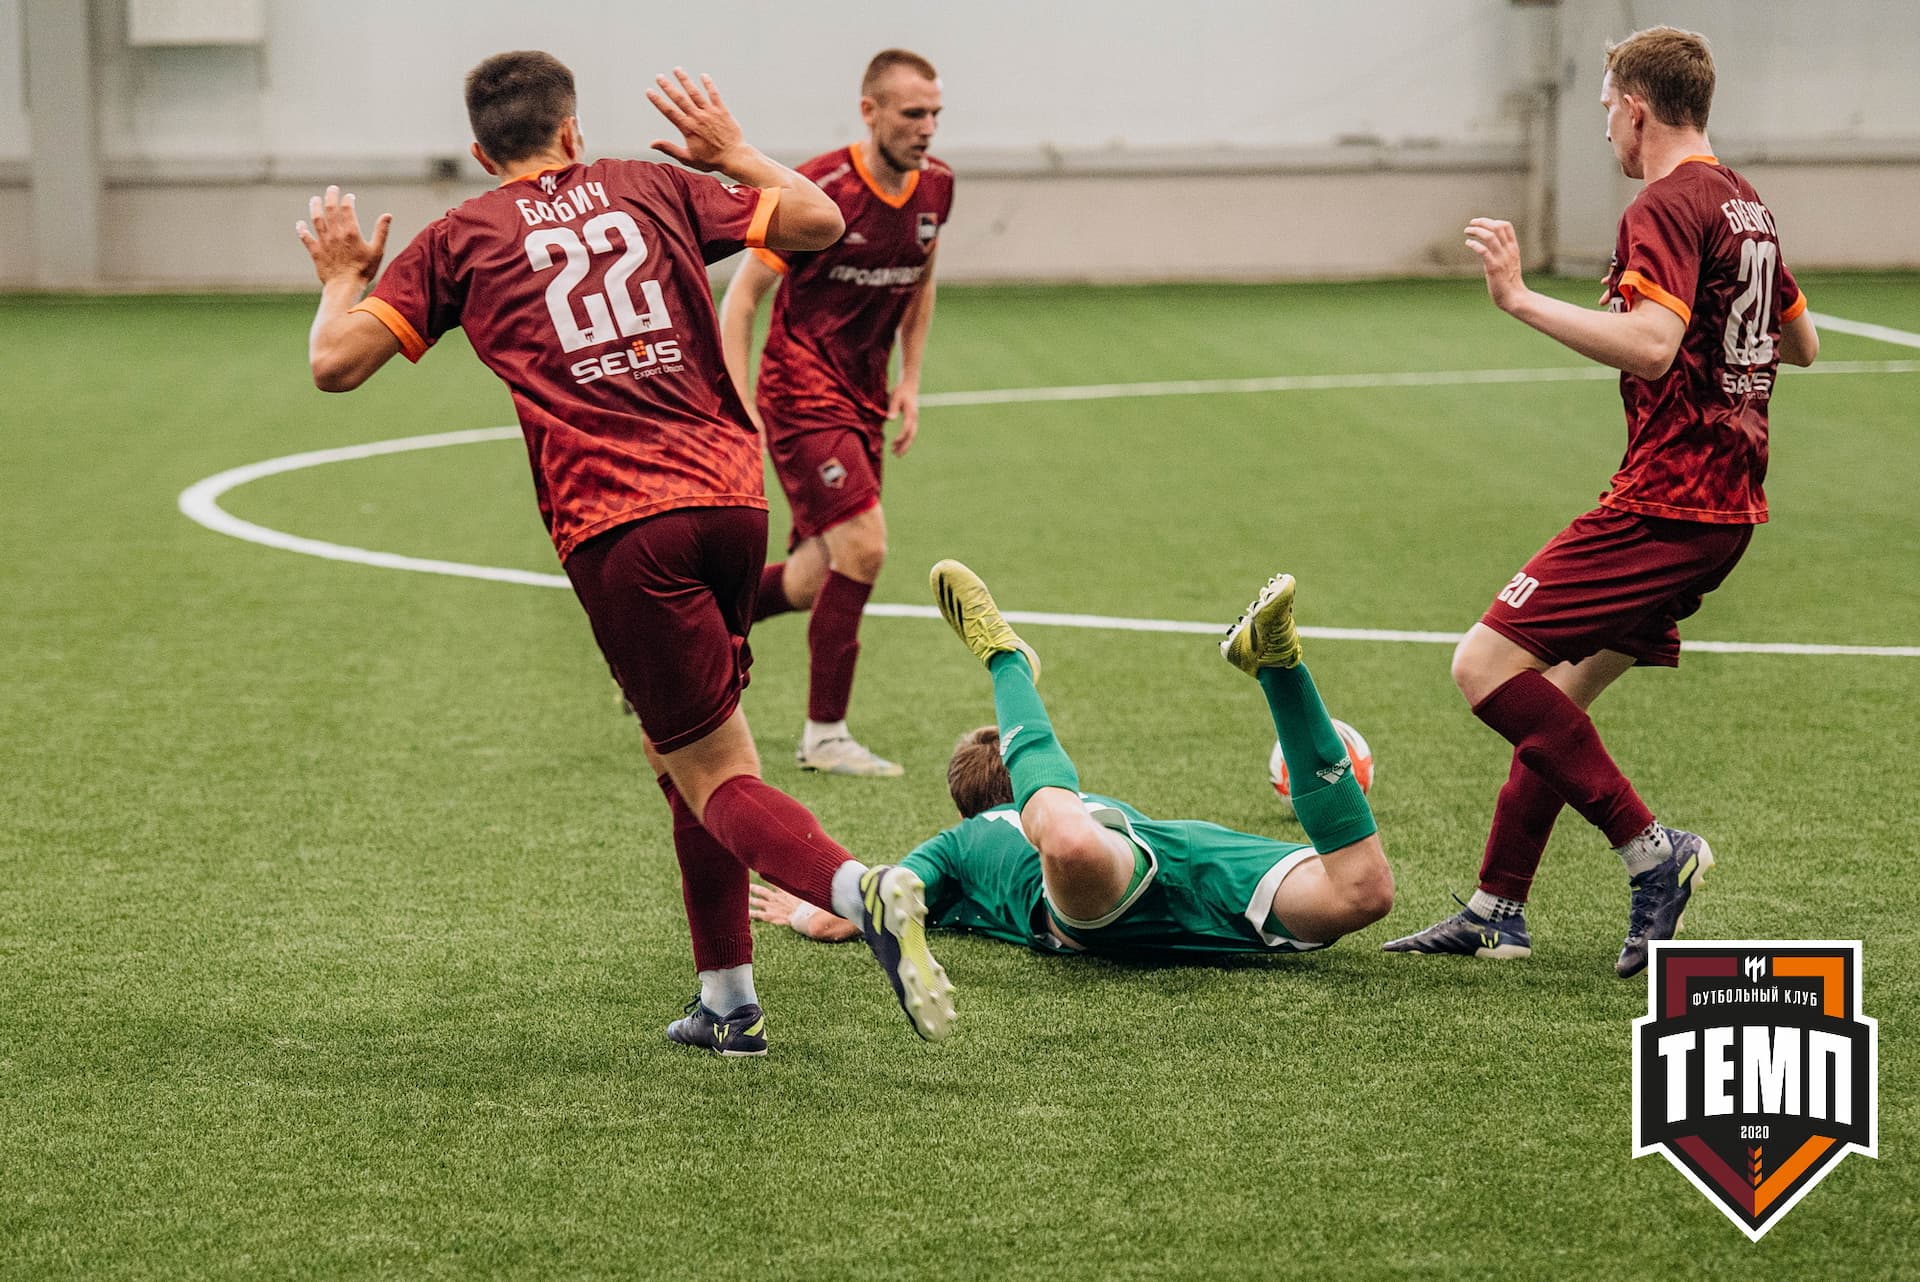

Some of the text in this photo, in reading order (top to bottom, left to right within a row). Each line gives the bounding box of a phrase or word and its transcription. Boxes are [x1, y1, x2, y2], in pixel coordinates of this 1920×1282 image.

[524, 211, 673, 354] 22
[1723, 238, 1777, 366] 20
[570, 340, 682, 384] SEUS
[633, 366, 662, 380] Export
[1497, 571, 1540, 609] 20
